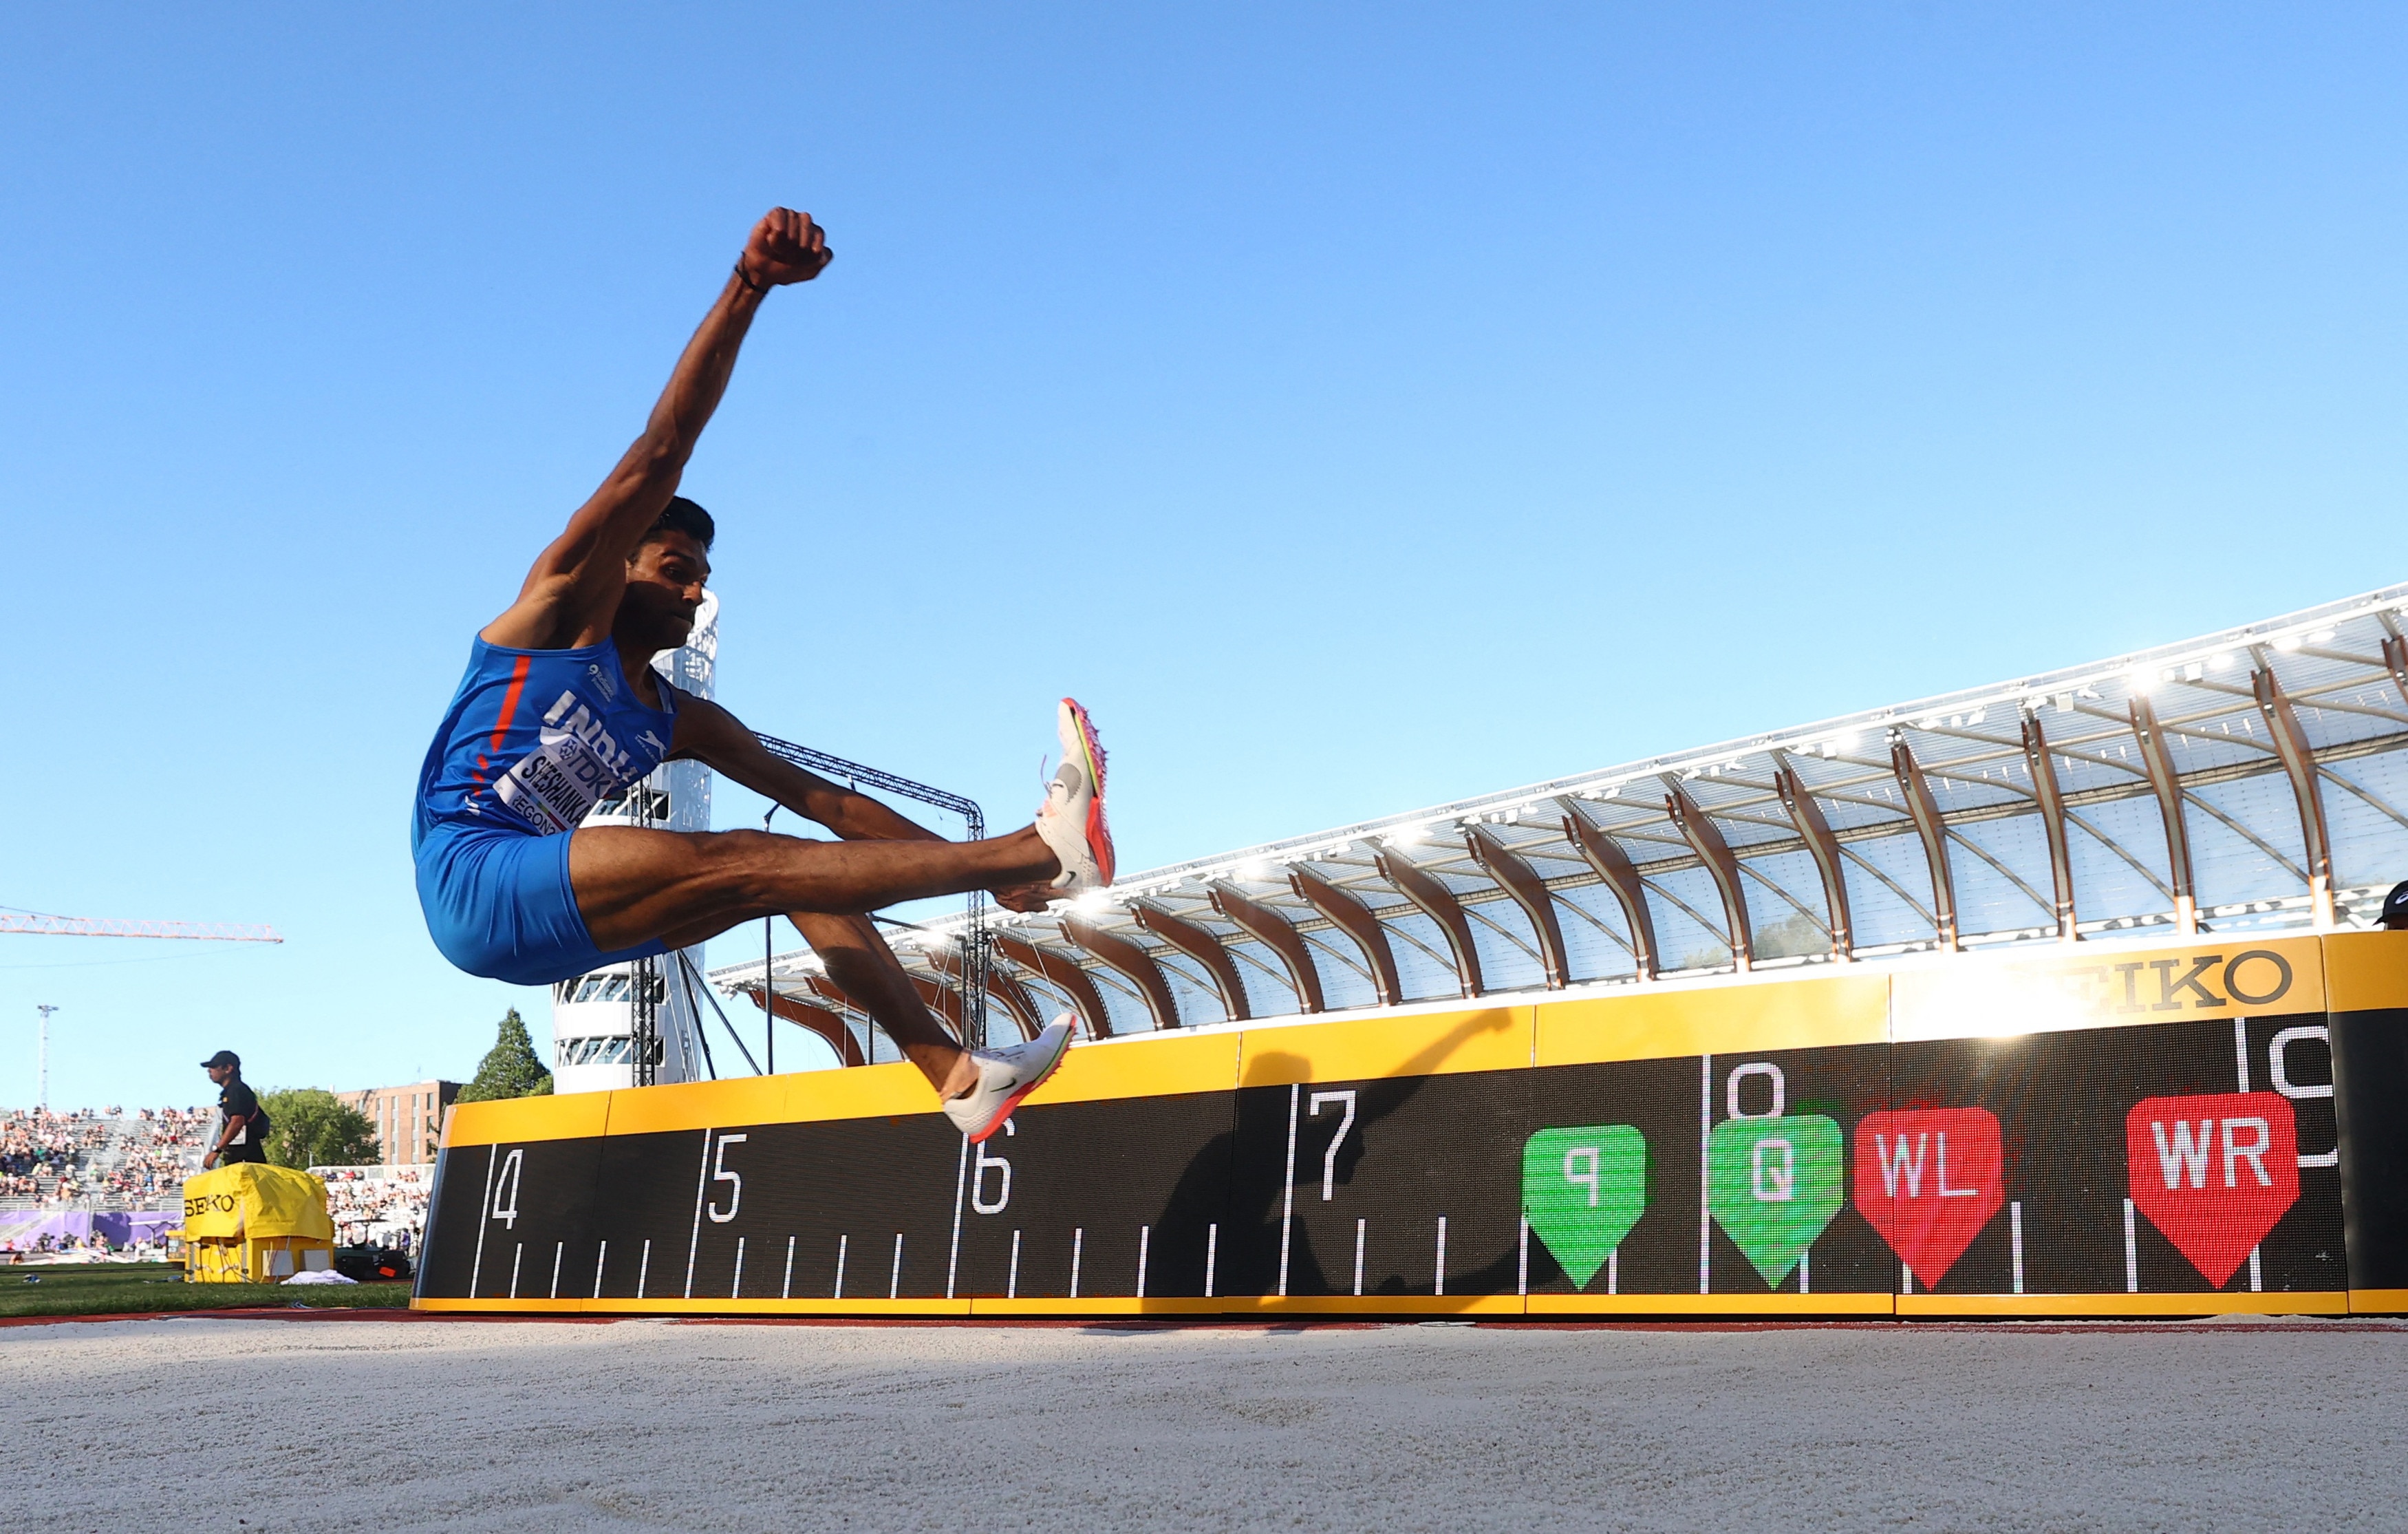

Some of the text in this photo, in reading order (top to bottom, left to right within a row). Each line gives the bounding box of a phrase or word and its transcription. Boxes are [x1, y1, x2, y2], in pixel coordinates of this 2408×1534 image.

[542, 690, 638, 782] INDI
[568, 747, 612, 799] TDK
[708, 1133, 747, 1223] 5
[971, 1118, 1015, 1214] 6
[1309, 1090, 1357, 1202] 7
[1752, 1138, 1795, 1202] Q
[1875, 1132, 1979, 1197] WL
[2151, 1117, 2272, 1190] WR
[184, 1194, 235, 1217] SEKO
[492, 1149, 524, 1230] 4
